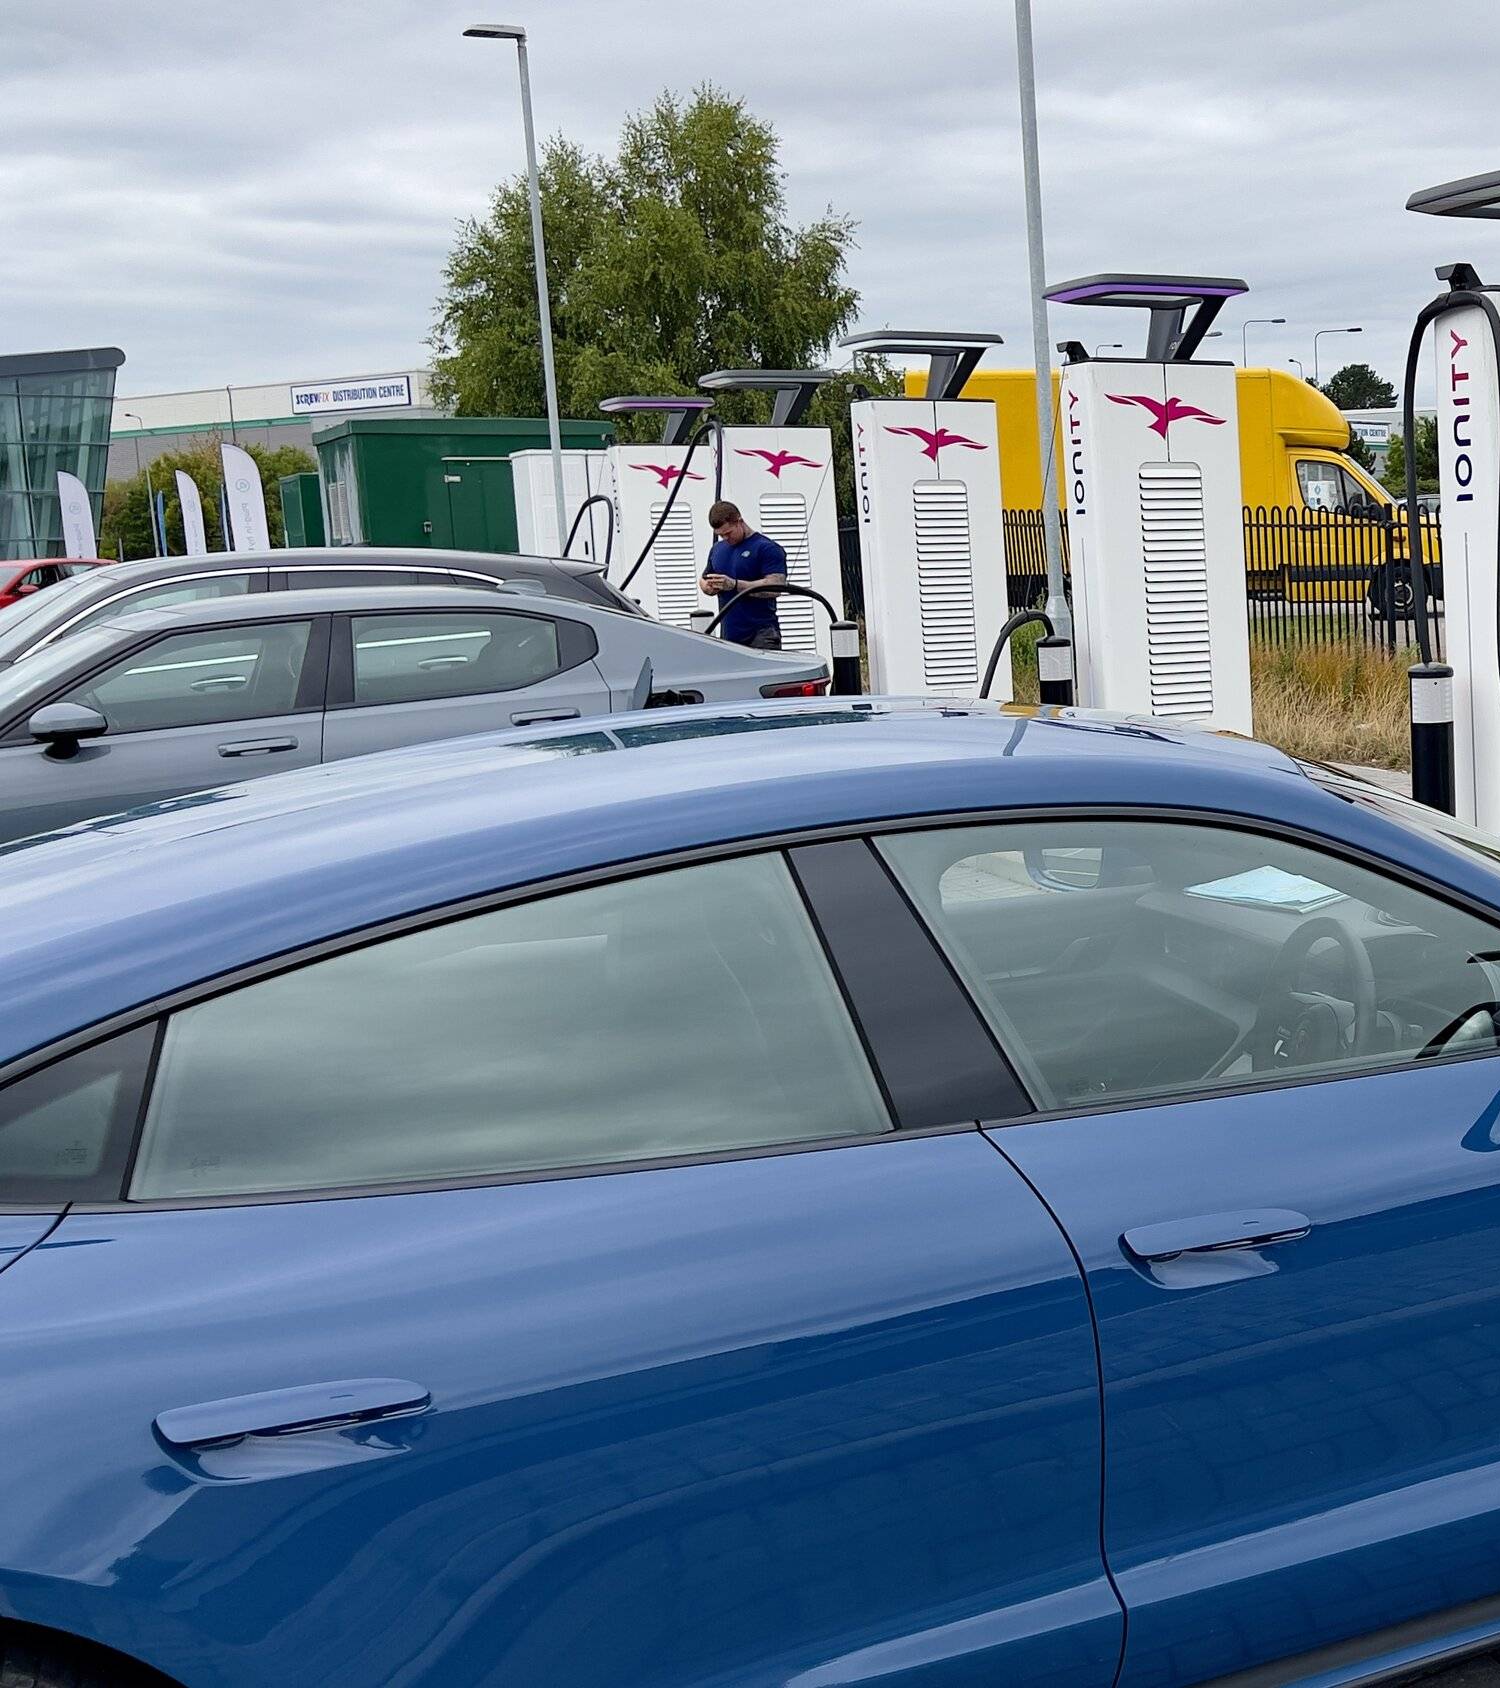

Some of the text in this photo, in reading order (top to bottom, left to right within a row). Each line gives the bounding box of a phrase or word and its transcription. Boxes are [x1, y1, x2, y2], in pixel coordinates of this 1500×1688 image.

[332, 387, 377, 402] DISTRIBUTION
[379, 384, 404, 398] CENTRE
[1450, 329, 1474, 502] IONITY
[857, 423, 870, 523] IONITY
[1068, 389, 1086, 515] IONITY
